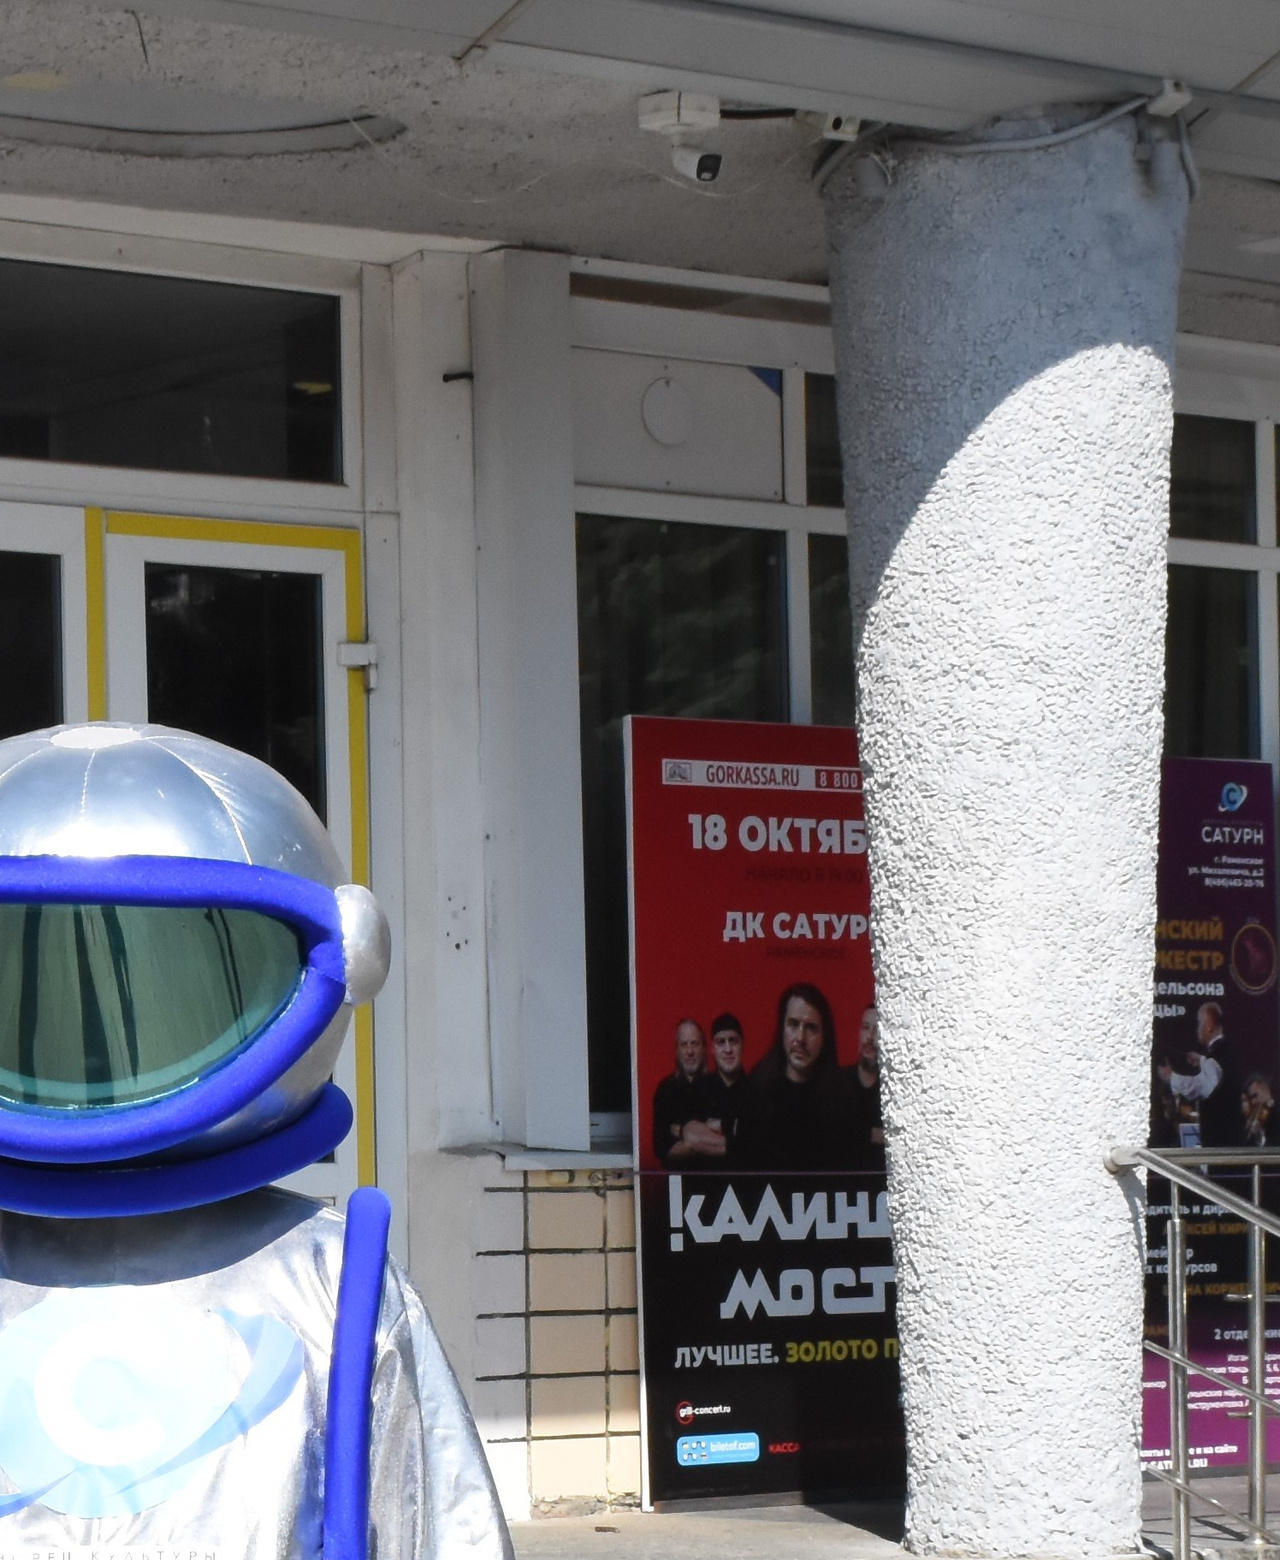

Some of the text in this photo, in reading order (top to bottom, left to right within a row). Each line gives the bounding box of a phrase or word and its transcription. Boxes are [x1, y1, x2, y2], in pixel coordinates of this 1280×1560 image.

[706, 764, 858, 788] GORKASSA.RU 8 800
[688, 813, 728, 851] 18
[1201, 826, 1264, 845] САТУРН
[723, 911, 872, 943] ДК САТУР
[1156, 950, 1224, 971] КЕСТР
[674, 1343, 780, 1369] ЛУЧШЕЕ.
[785, 1338, 878, 1363] ЗОЛОТО
